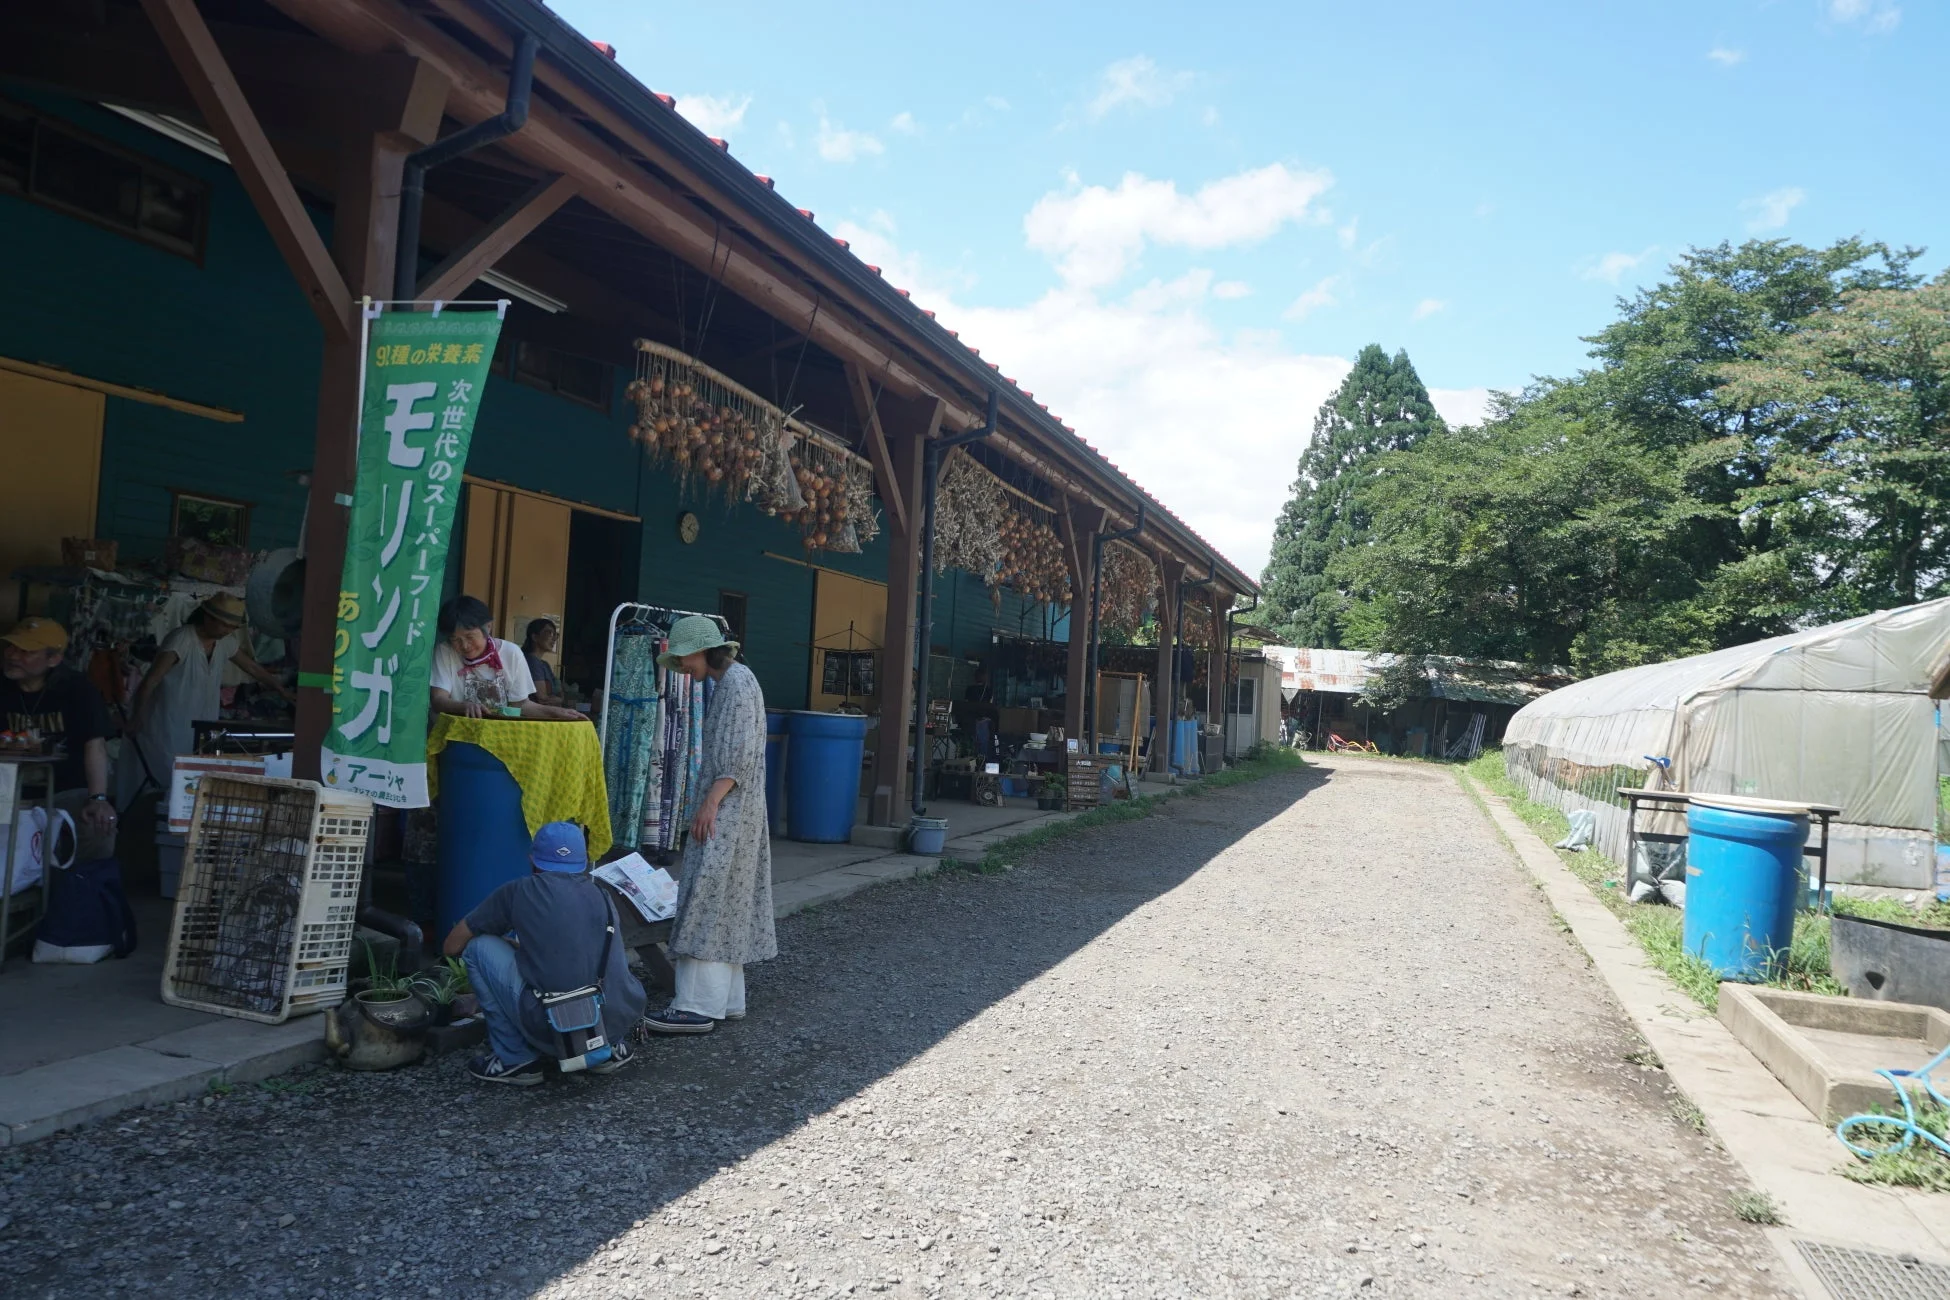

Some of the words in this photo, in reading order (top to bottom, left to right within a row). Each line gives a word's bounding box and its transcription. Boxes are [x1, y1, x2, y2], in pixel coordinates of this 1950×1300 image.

[338, 381, 438, 744] モリンガ
[406, 379, 473, 646] 次世代のスーパーフード
[347, 763, 405, 792] アーシャ
